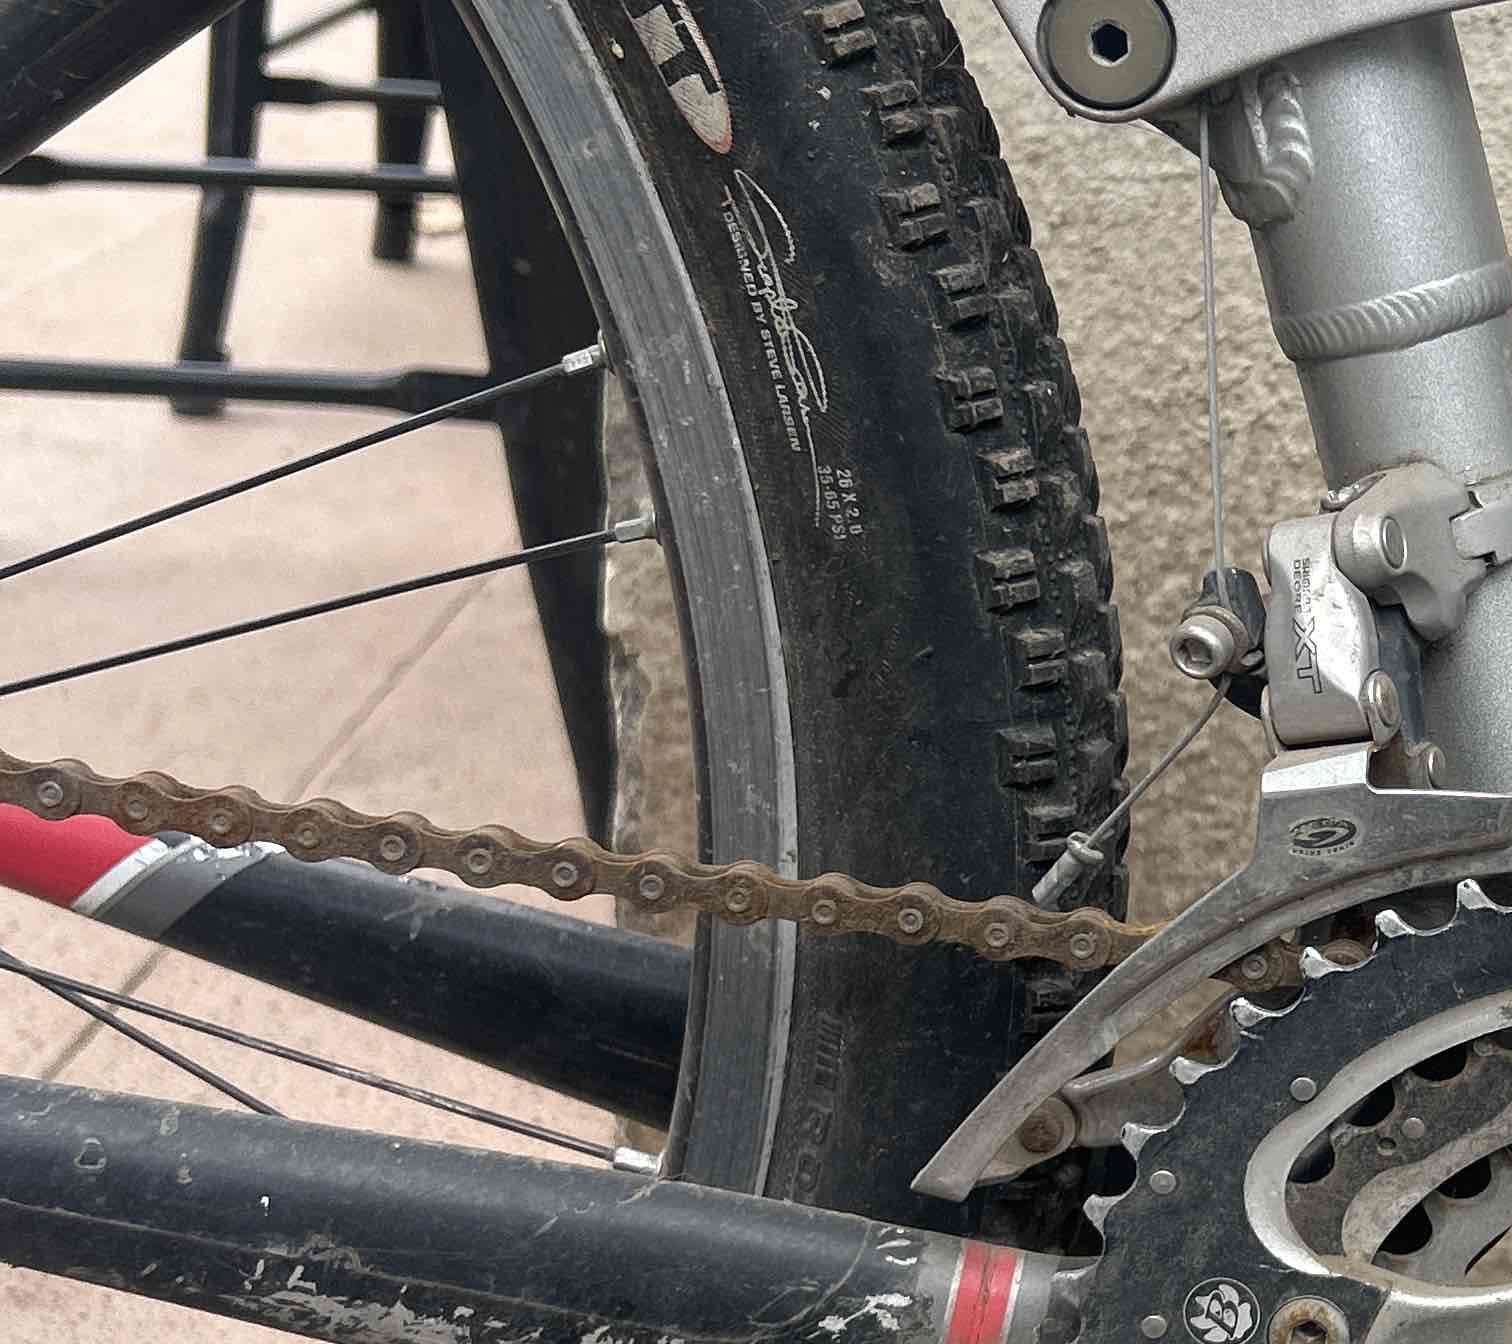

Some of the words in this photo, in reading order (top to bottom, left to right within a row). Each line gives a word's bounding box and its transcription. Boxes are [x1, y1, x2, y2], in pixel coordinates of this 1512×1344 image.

[749, 299, 768, 328] BY
[759, 327, 782, 382] STEVE
[1292, 616, 1323, 694] XT
